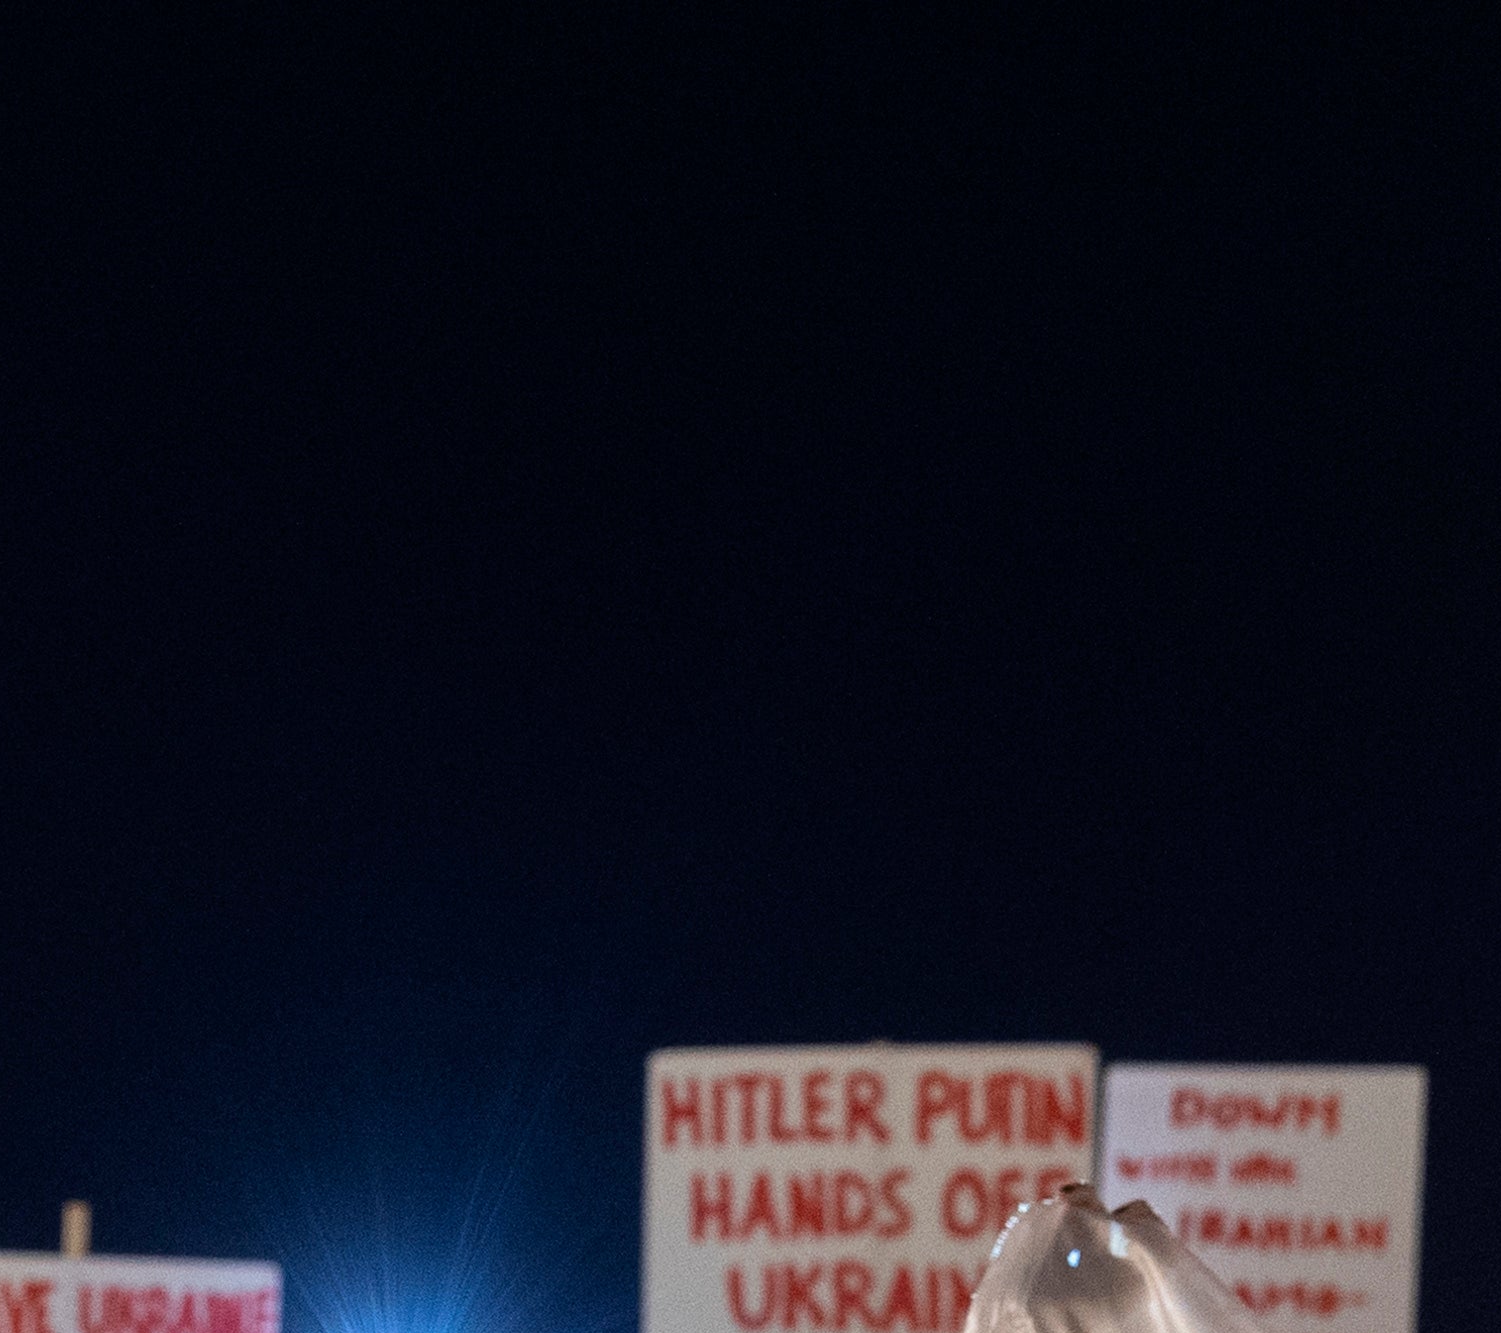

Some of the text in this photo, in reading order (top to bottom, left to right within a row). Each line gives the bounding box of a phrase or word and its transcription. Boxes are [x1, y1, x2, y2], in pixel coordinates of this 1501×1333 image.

[661, 1068, 1088, 1149] HITLER PUTIN
[690, 1166, 913, 1243] HANDS
